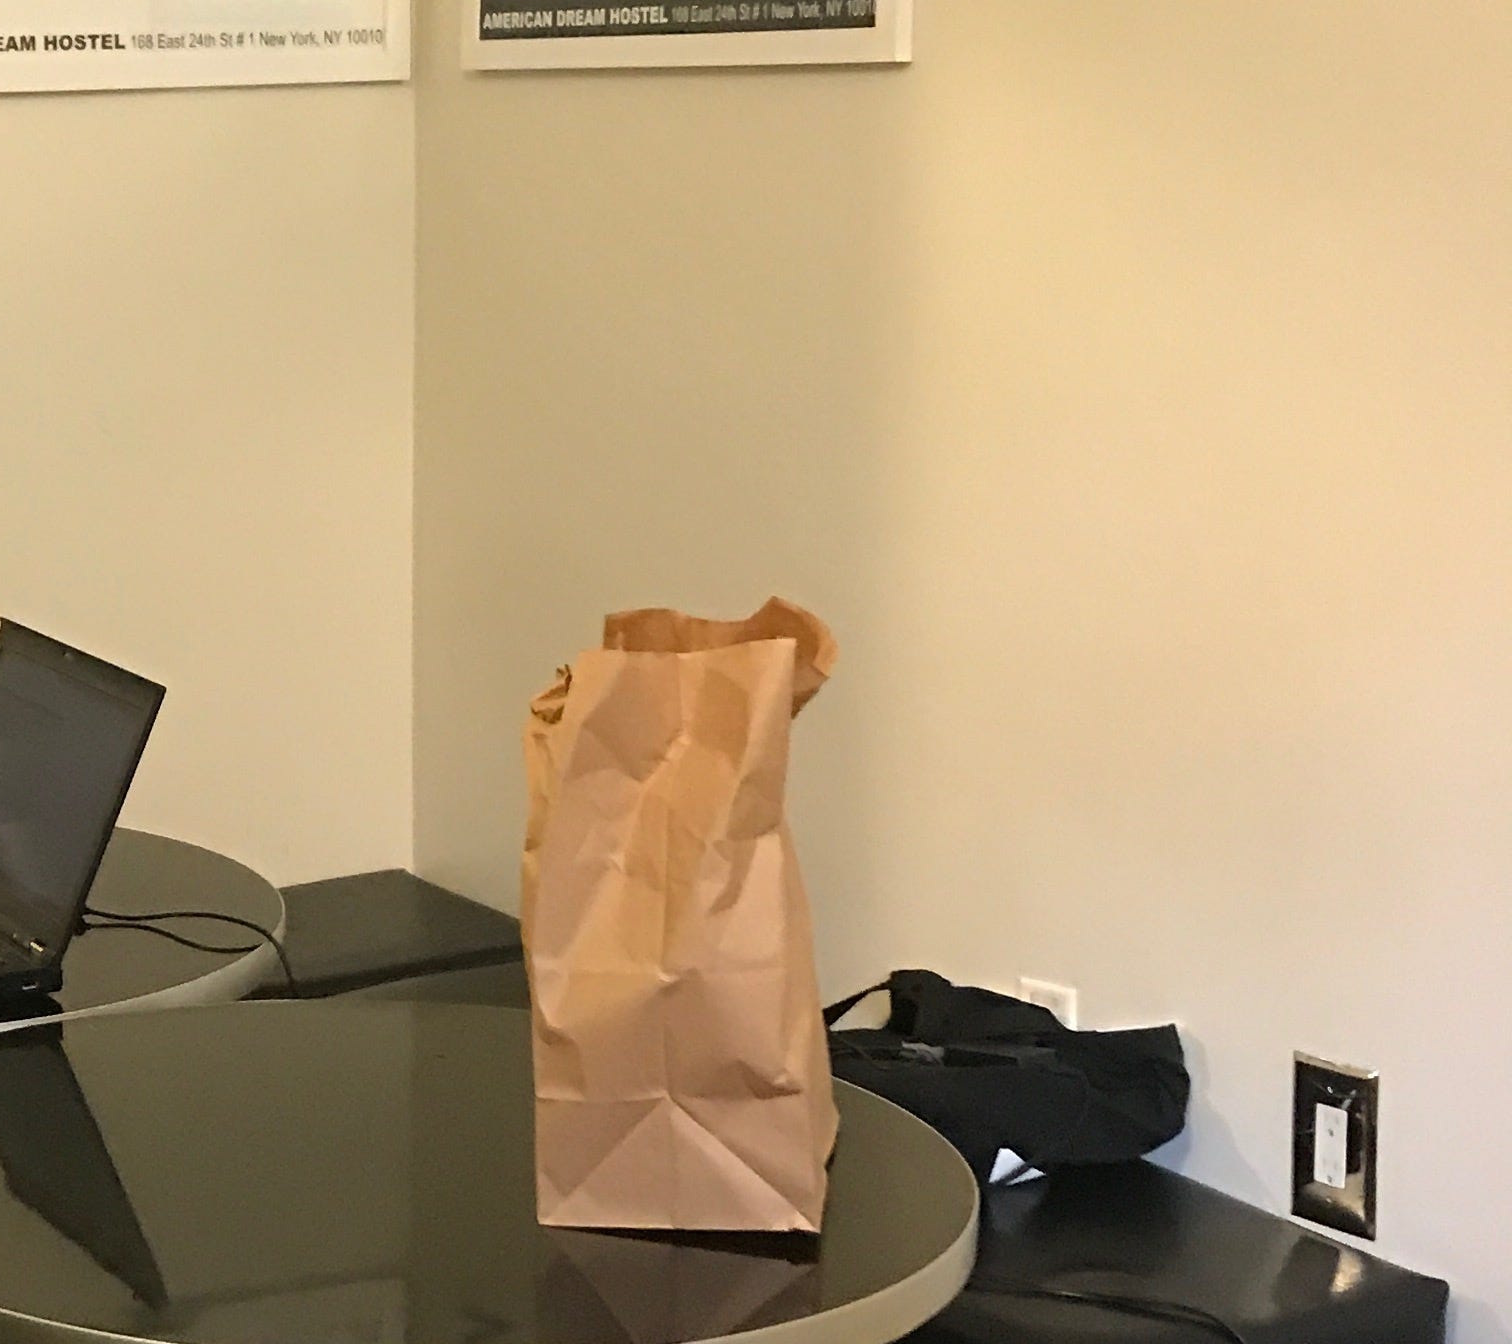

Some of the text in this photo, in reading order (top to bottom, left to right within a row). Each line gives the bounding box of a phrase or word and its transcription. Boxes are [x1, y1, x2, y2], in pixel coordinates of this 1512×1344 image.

[483, 11, 553, 29] AMERICAN
[556, 8, 606, 27] DREAM
[609, 5, 669, 25] HOSTEL
[43, 34, 126, 51] HOSTEL
[131, 34, 154, 50] 168
[157, 33, 185, 49] East
[188, 33, 216, 48] 24th
[220, 32, 233, 48] St
[259, 31, 286, 47] New
[323, 30, 342, 45] NY
[347, 29, 384, 45] 10010
